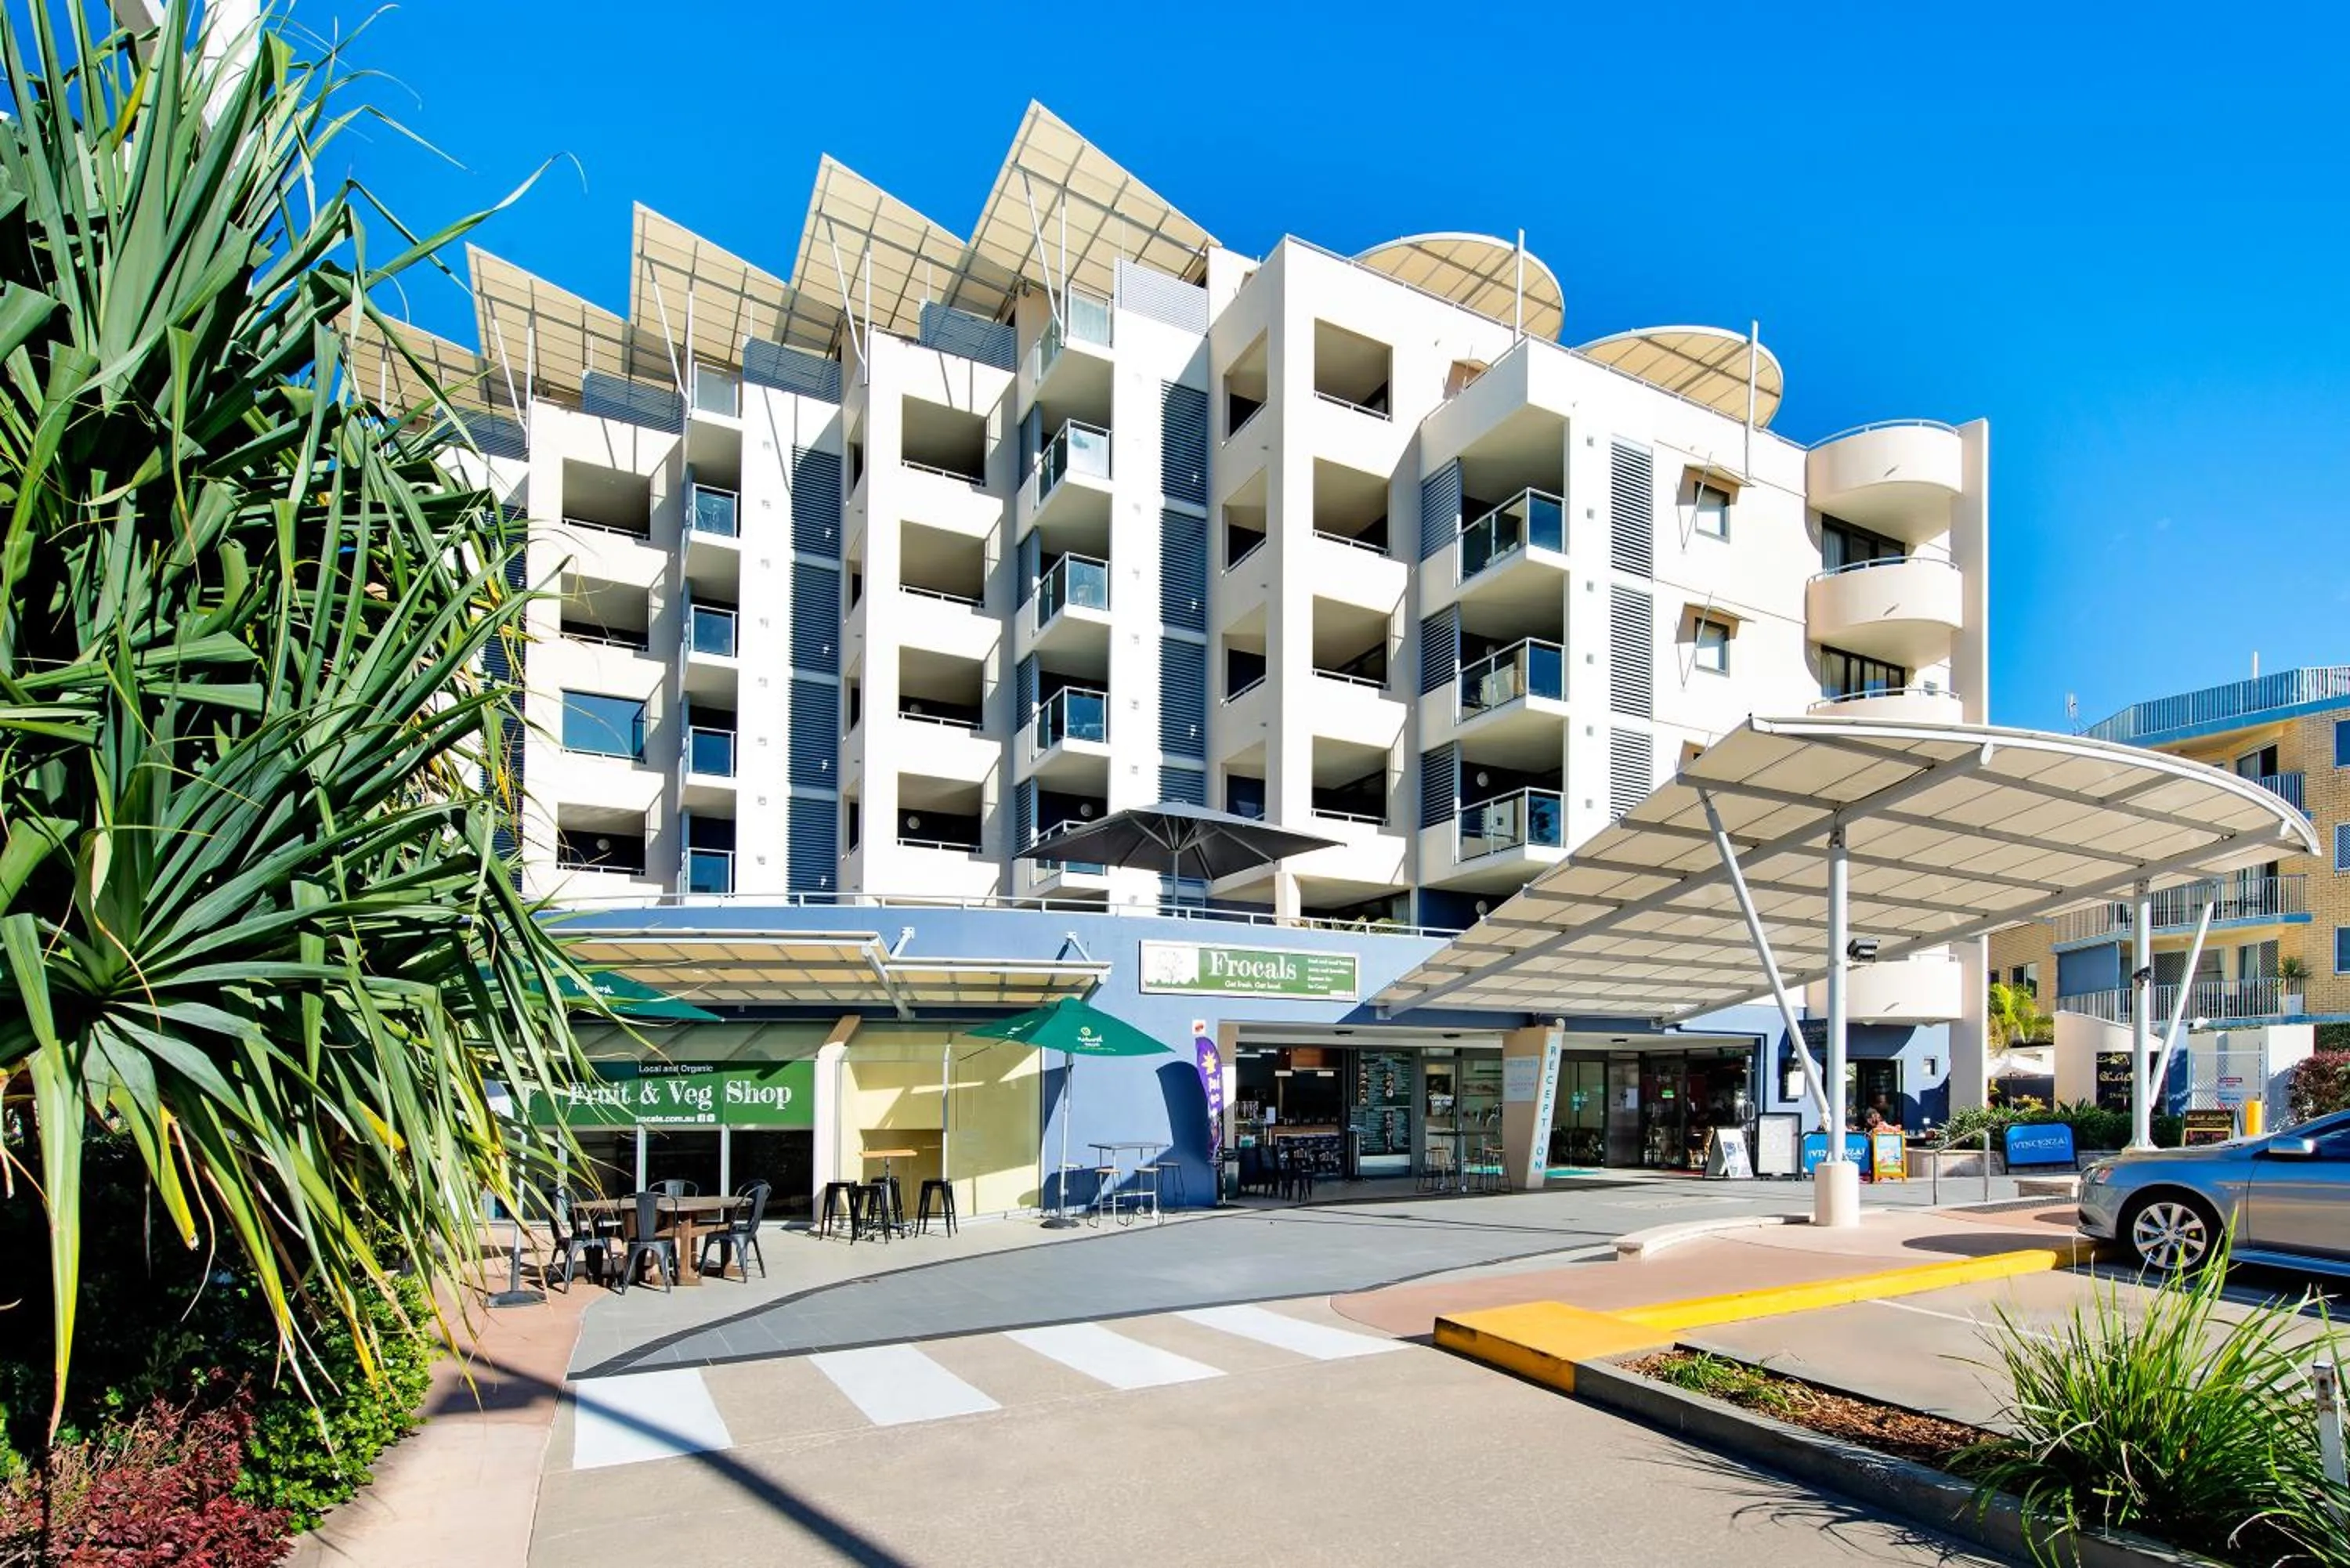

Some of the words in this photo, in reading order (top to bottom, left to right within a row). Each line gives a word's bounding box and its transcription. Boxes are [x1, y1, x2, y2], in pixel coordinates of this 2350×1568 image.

[1207, 951, 1297, 980] Frocals
[638, 1064, 661, 1073] Local
[663, 1064, 678, 1073] and
[680, 1064, 714, 1074] Organic
[567, 1081, 631, 1105] Fruit
[640, 1080, 660, 1105] &
[666, 1080, 713, 1111] Veg
[726, 1079, 792, 1111] Shop
[1534, 1046, 1557, 1169] RECEPTION
